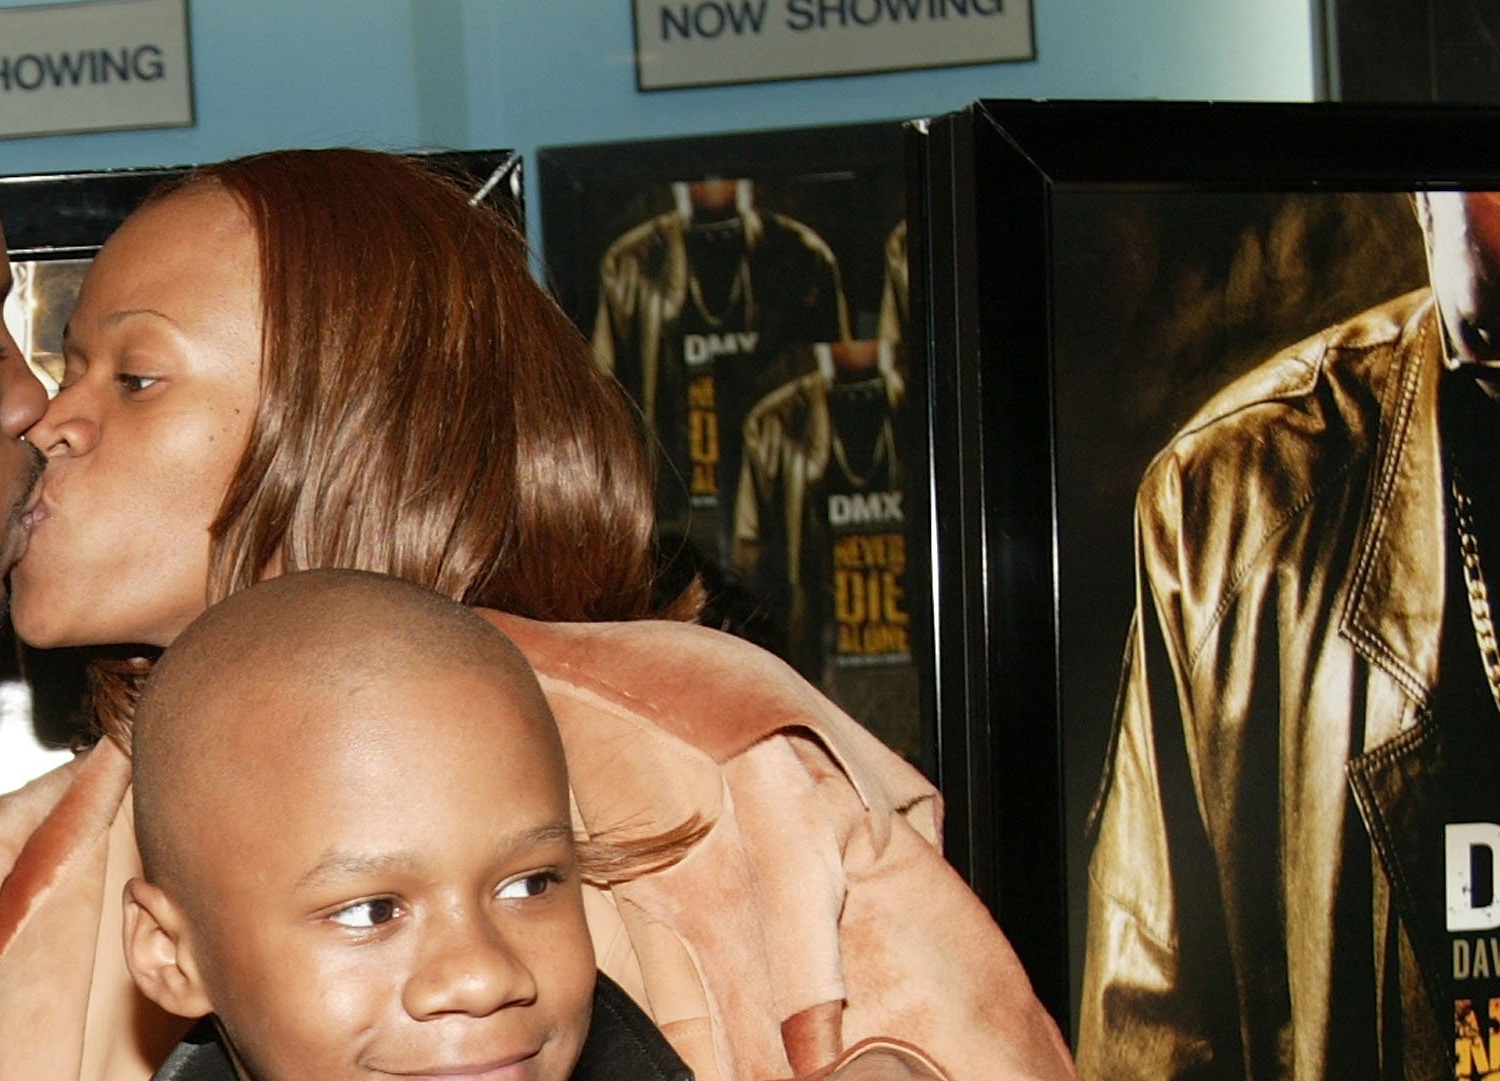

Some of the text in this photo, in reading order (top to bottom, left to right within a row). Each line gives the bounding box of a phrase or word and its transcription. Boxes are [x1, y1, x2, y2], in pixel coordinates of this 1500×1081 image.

[660, 0, 766, 41] NOW
[828, 491, 904, 525] DMX
[835, 570, 911, 623] DIE
